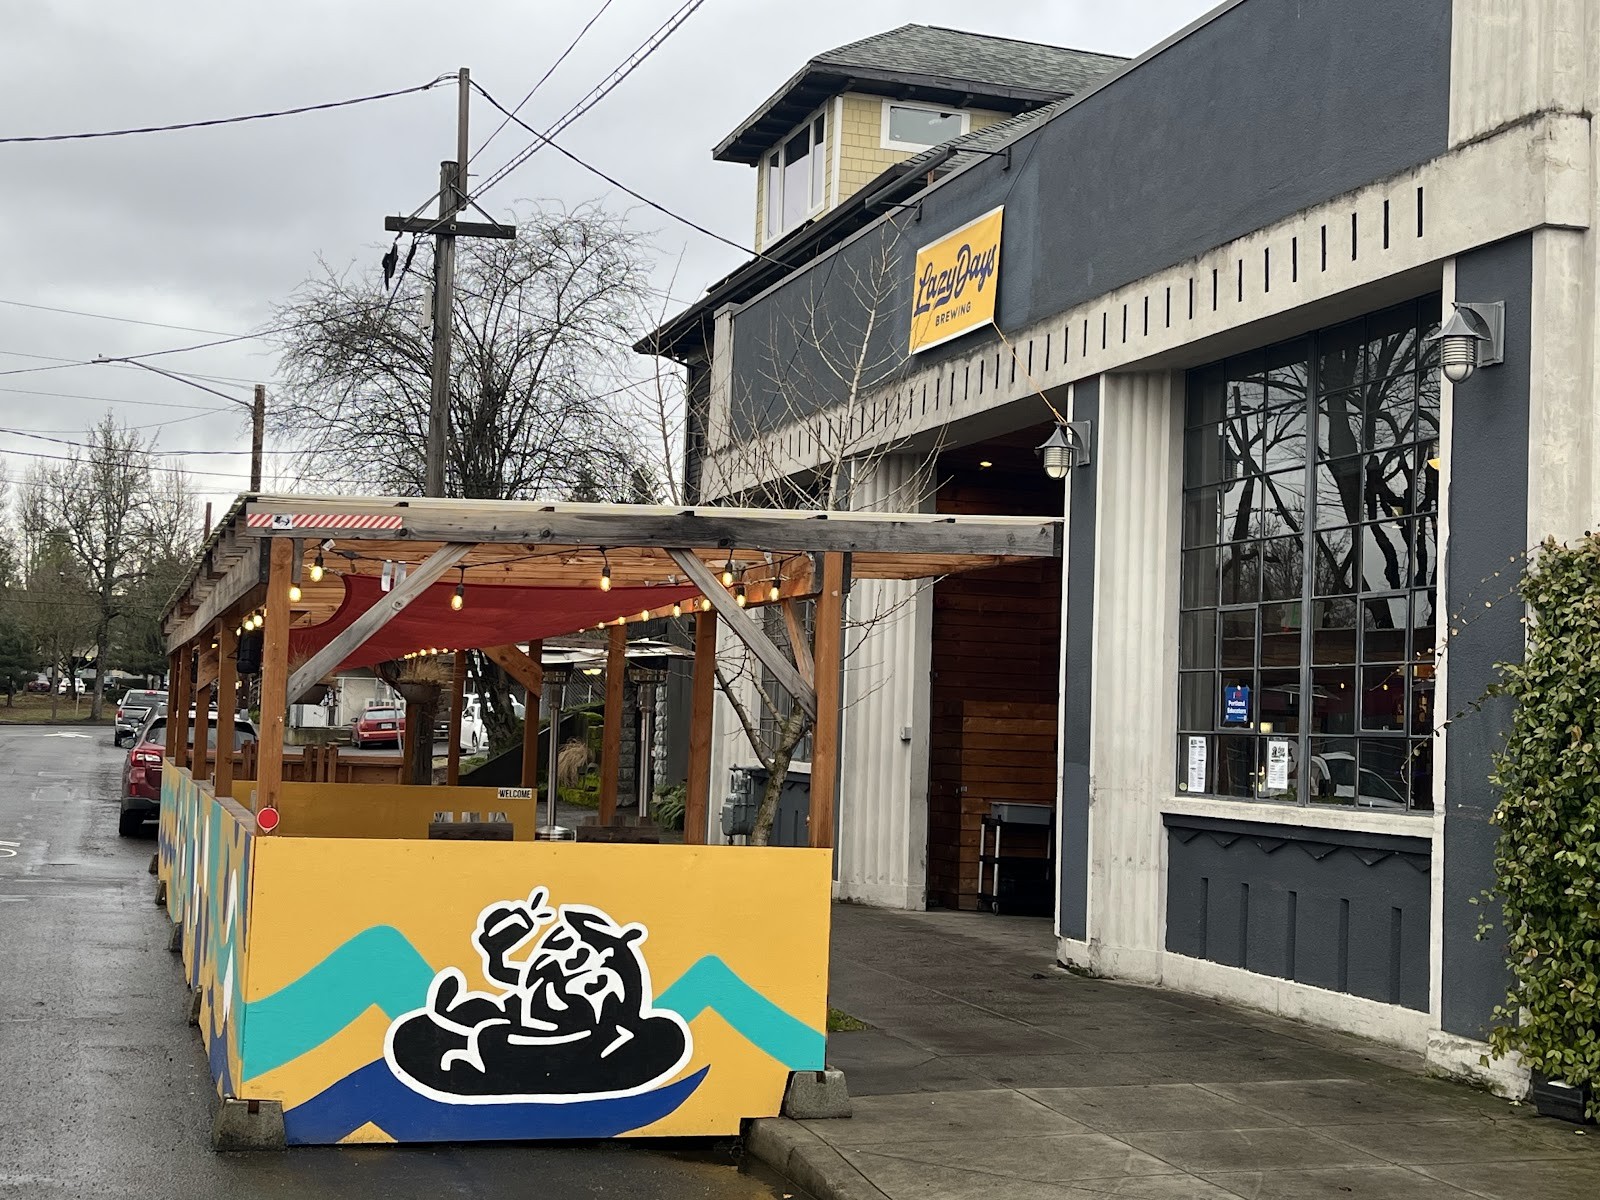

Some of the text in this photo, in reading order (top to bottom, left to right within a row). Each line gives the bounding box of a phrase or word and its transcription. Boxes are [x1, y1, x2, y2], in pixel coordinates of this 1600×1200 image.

[914, 243, 997, 317] Lazy Days
[935, 301, 971, 327] BREWING
[499, 789, 531, 798] WELCOME
